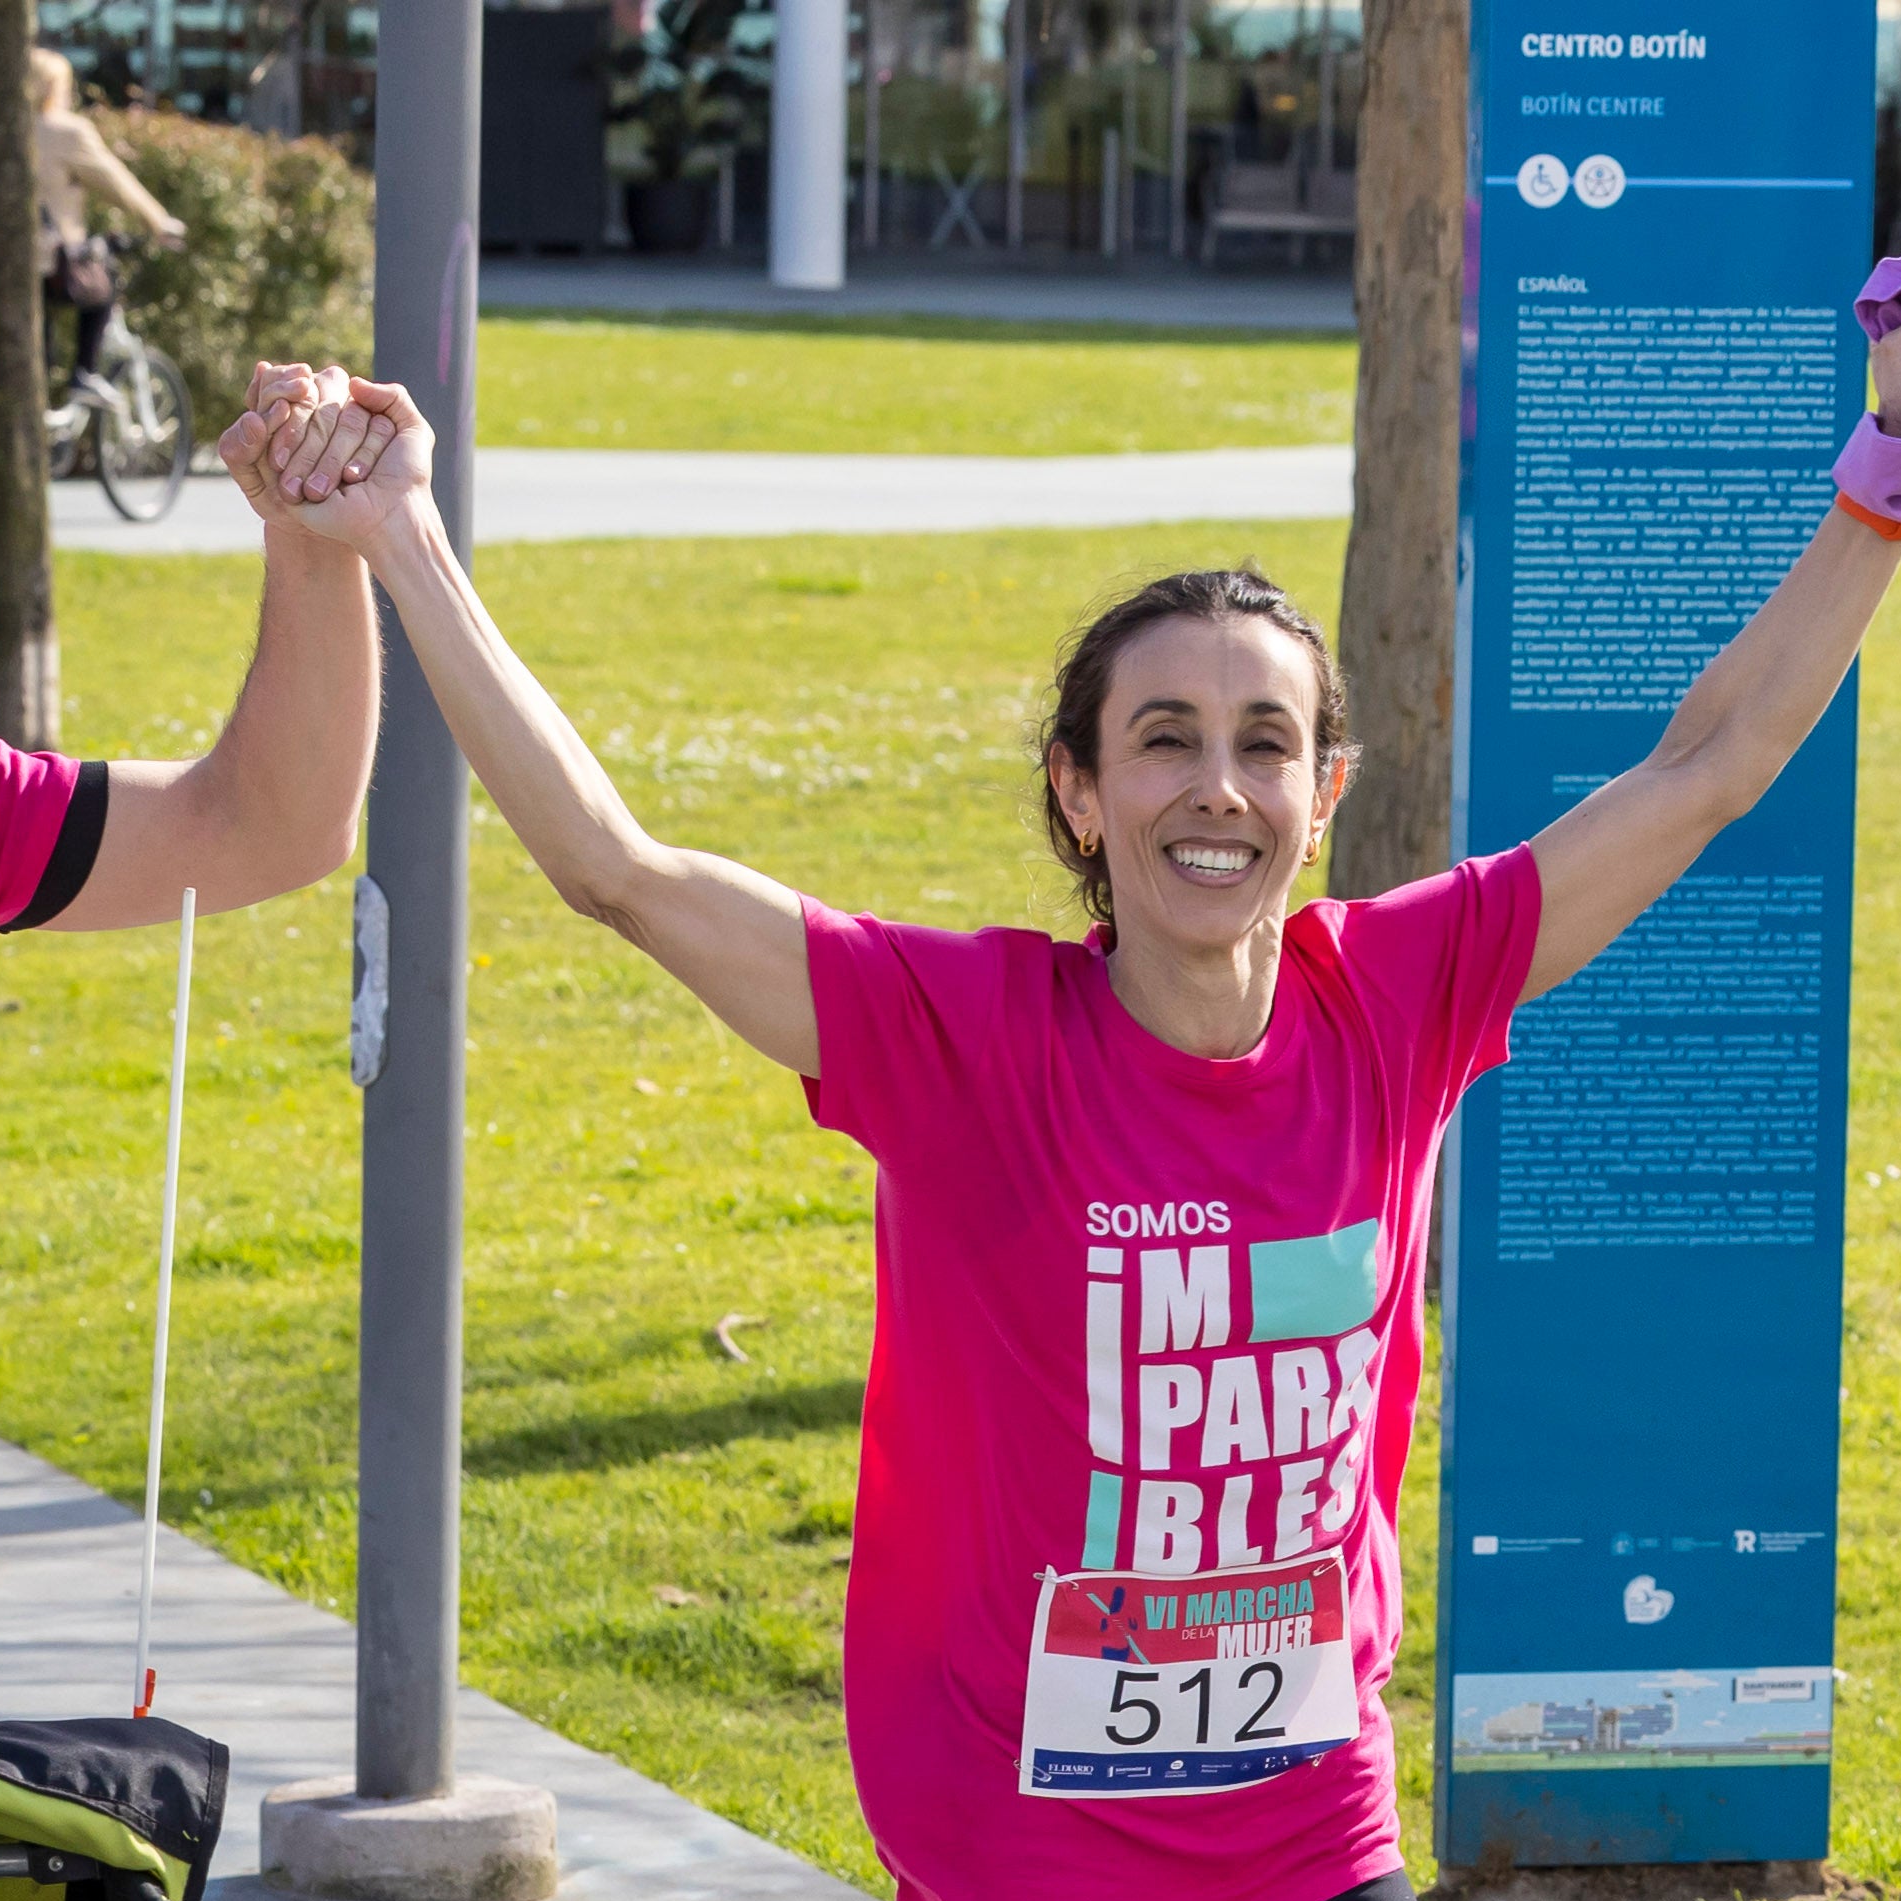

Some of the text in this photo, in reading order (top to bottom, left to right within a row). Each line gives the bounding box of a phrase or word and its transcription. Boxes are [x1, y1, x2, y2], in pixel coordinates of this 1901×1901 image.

[1521, 29, 1706, 59] CENTRO BOTÍN
[1521, 93, 1665, 117] BOTÍN CENTRE
[1518, 274, 1588, 293] ESPAÑOL
[1085, 1201, 1231, 1238] SOMOS
[1139, 1327, 1379, 1471] PARA
[1144, 1579, 1315, 1630] VI MARCHA
[1182, 1614, 1312, 1660] DE LA MUJER
[1105, 1661, 1286, 1746] 512
